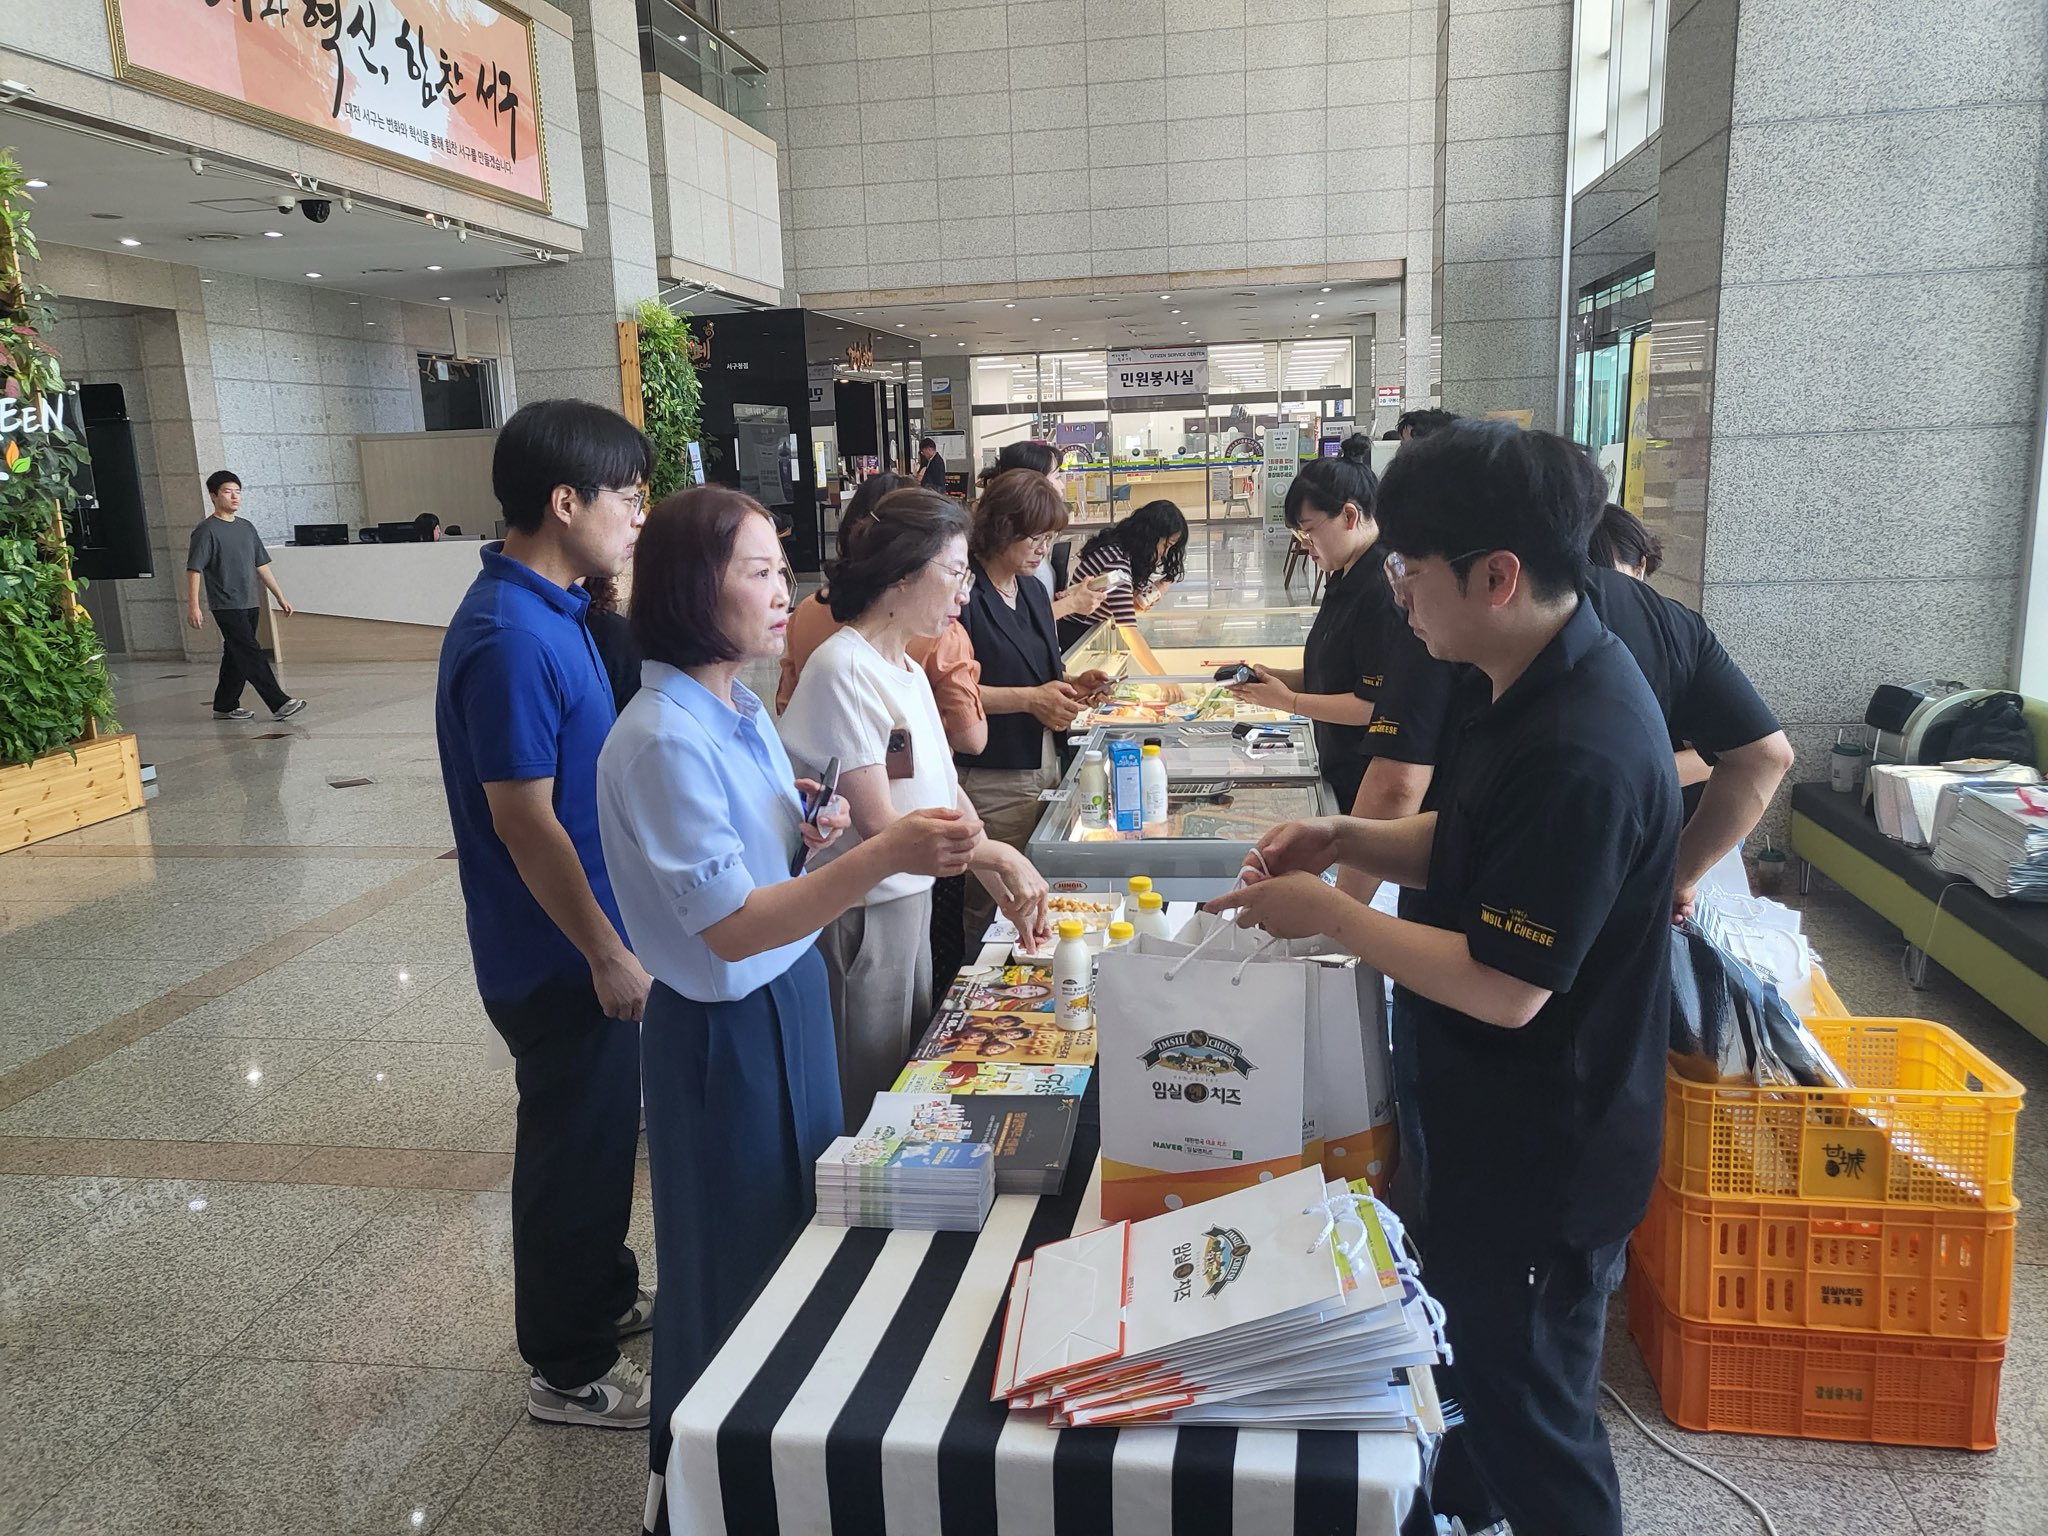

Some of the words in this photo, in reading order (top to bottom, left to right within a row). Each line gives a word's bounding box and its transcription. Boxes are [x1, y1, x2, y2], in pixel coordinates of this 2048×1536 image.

[395, 19, 466, 108] 힘찬
[476, 61, 518, 164] 서구
[344, 102, 361, 121] 대전
[362, 109, 386, 130] 서구는
[386, 116, 409, 139] 변화와
[408, 125, 430, 146] 혁신을
[430, 133, 445, 152] 통해
[444, 139, 459, 157] 힘찬
[458, 144, 478, 163] 서구를
[477, 151, 514, 175] 만들겠습니다.
[1120, 369, 1194, 388] 민원봉사실
[1481, 909, 1503, 929] IMSIL
[1504, 919, 1513, 933] N
[1513, 922, 1554, 948] CHEESE
[1157, 1036, 1187, 1051] IMSIL
[1208, 1038, 1239, 1058] CHEESE
[1152, 1141, 1183, 1152] NAVER
[1225, 1230, 1243, 1247] IMSIL
[1225, 1257, 1243, 1282] CHEESE
